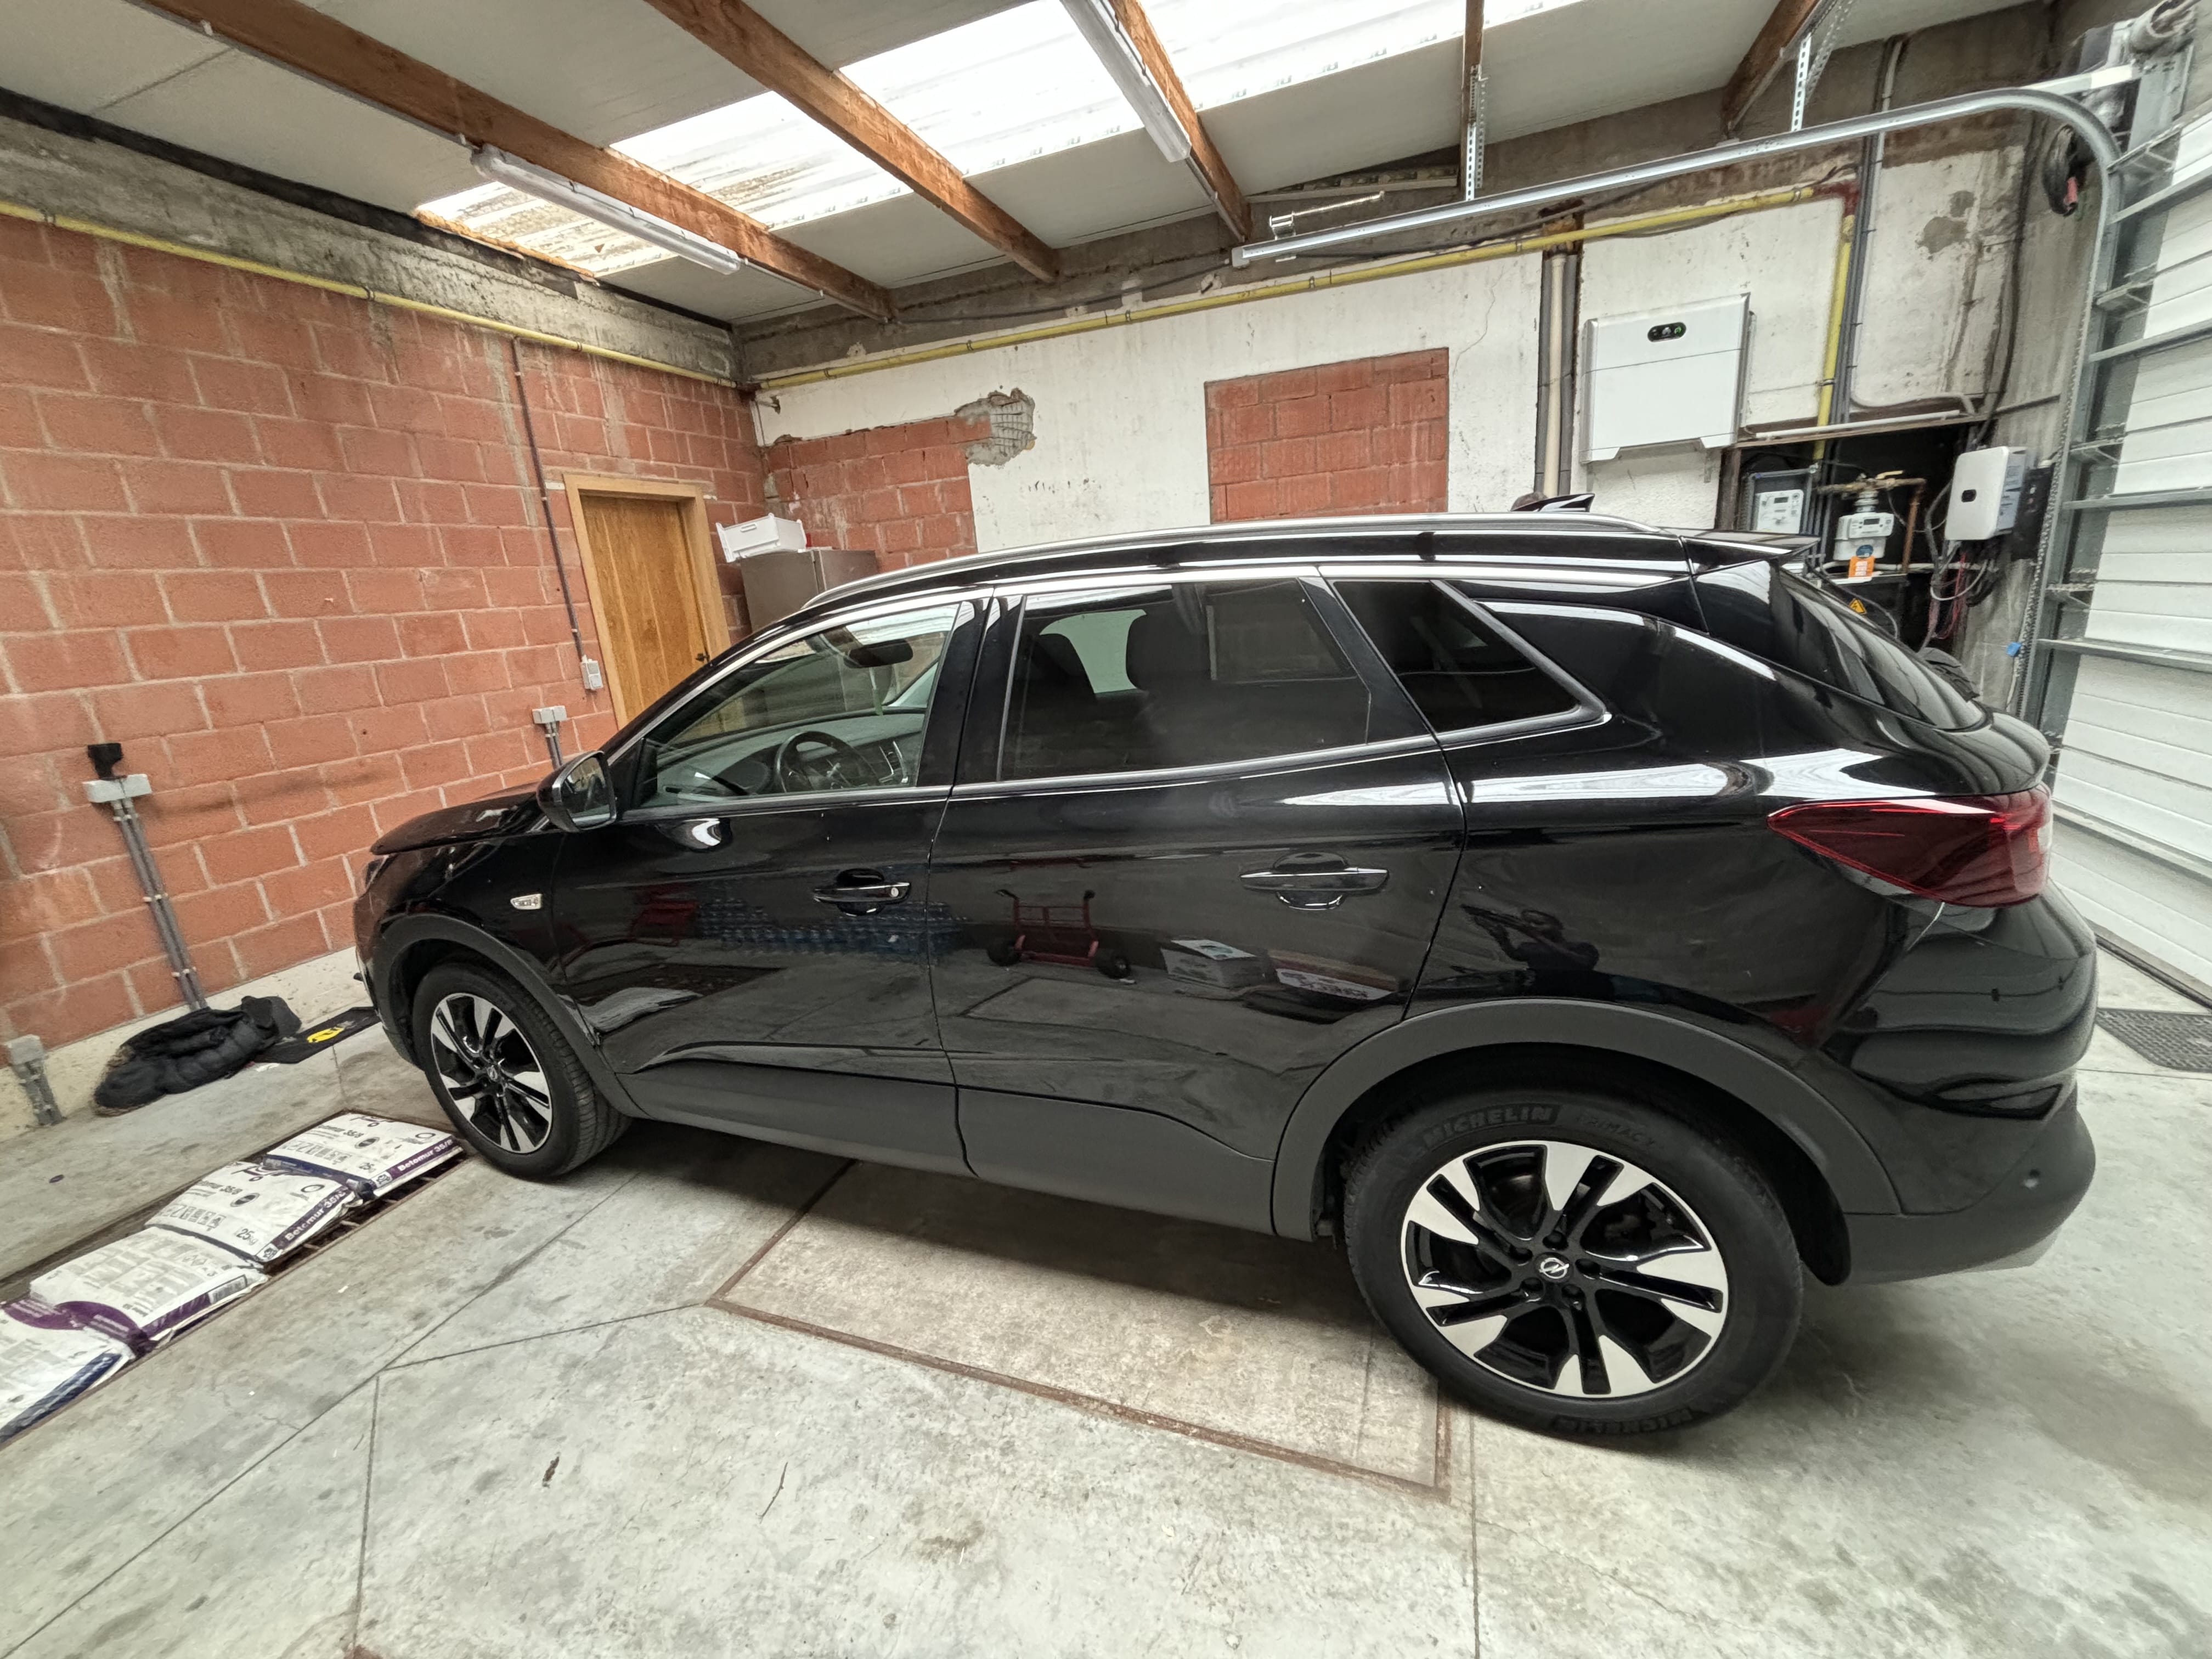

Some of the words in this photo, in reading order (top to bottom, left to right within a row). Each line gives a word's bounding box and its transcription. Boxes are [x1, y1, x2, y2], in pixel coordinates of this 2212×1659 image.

[1423, 1106, 1554, 1147] MICHELIN
[397, 1150, 433, 1171] Betomur
[285, 1207, 325, 1240] Betomur
